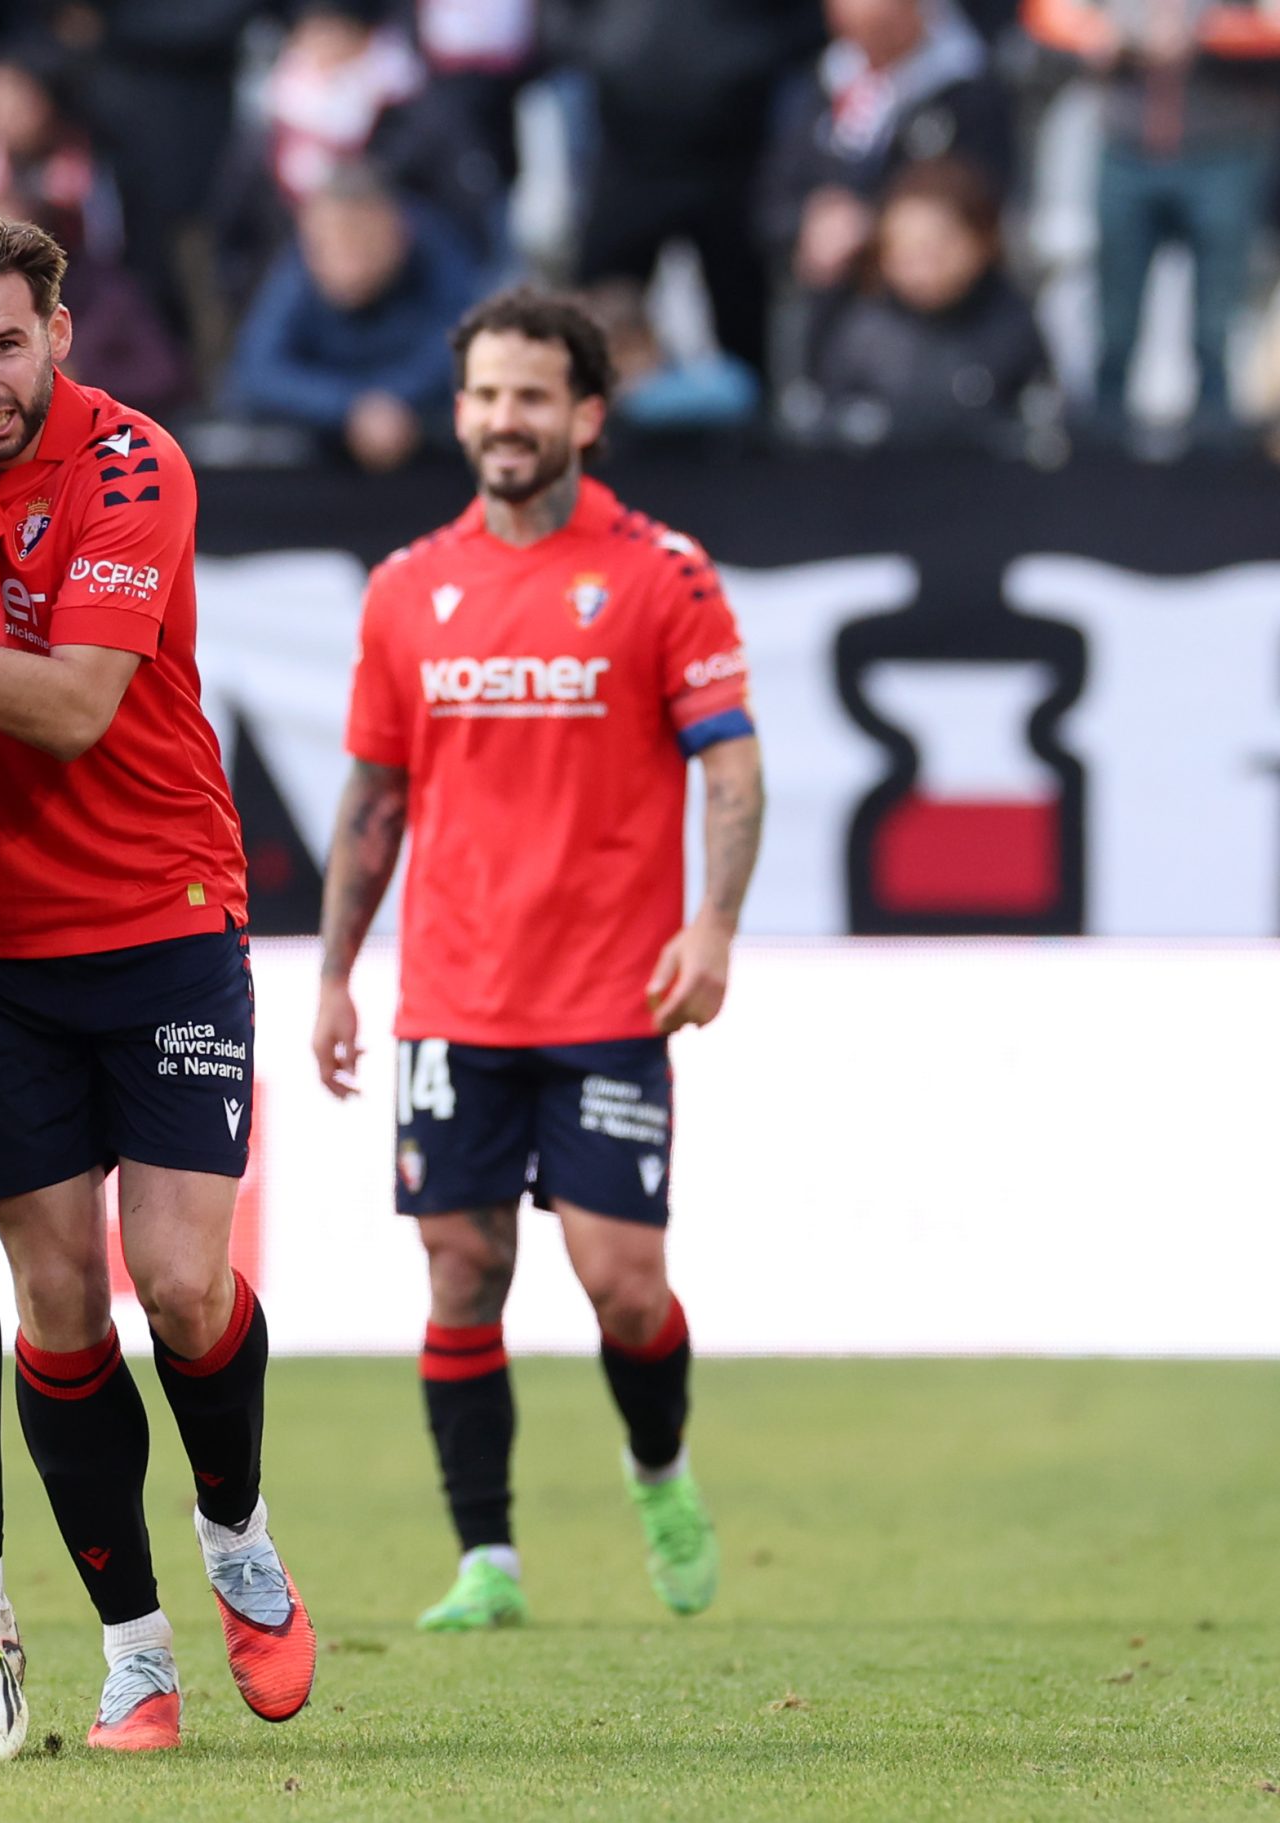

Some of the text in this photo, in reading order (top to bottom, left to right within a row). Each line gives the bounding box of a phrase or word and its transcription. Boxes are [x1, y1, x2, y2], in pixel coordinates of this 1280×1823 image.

[92, 560, 160, 591] CELER
[158, 1056, 244, 1081] de Navarra
[399, 1037, 457, 1125] 14
